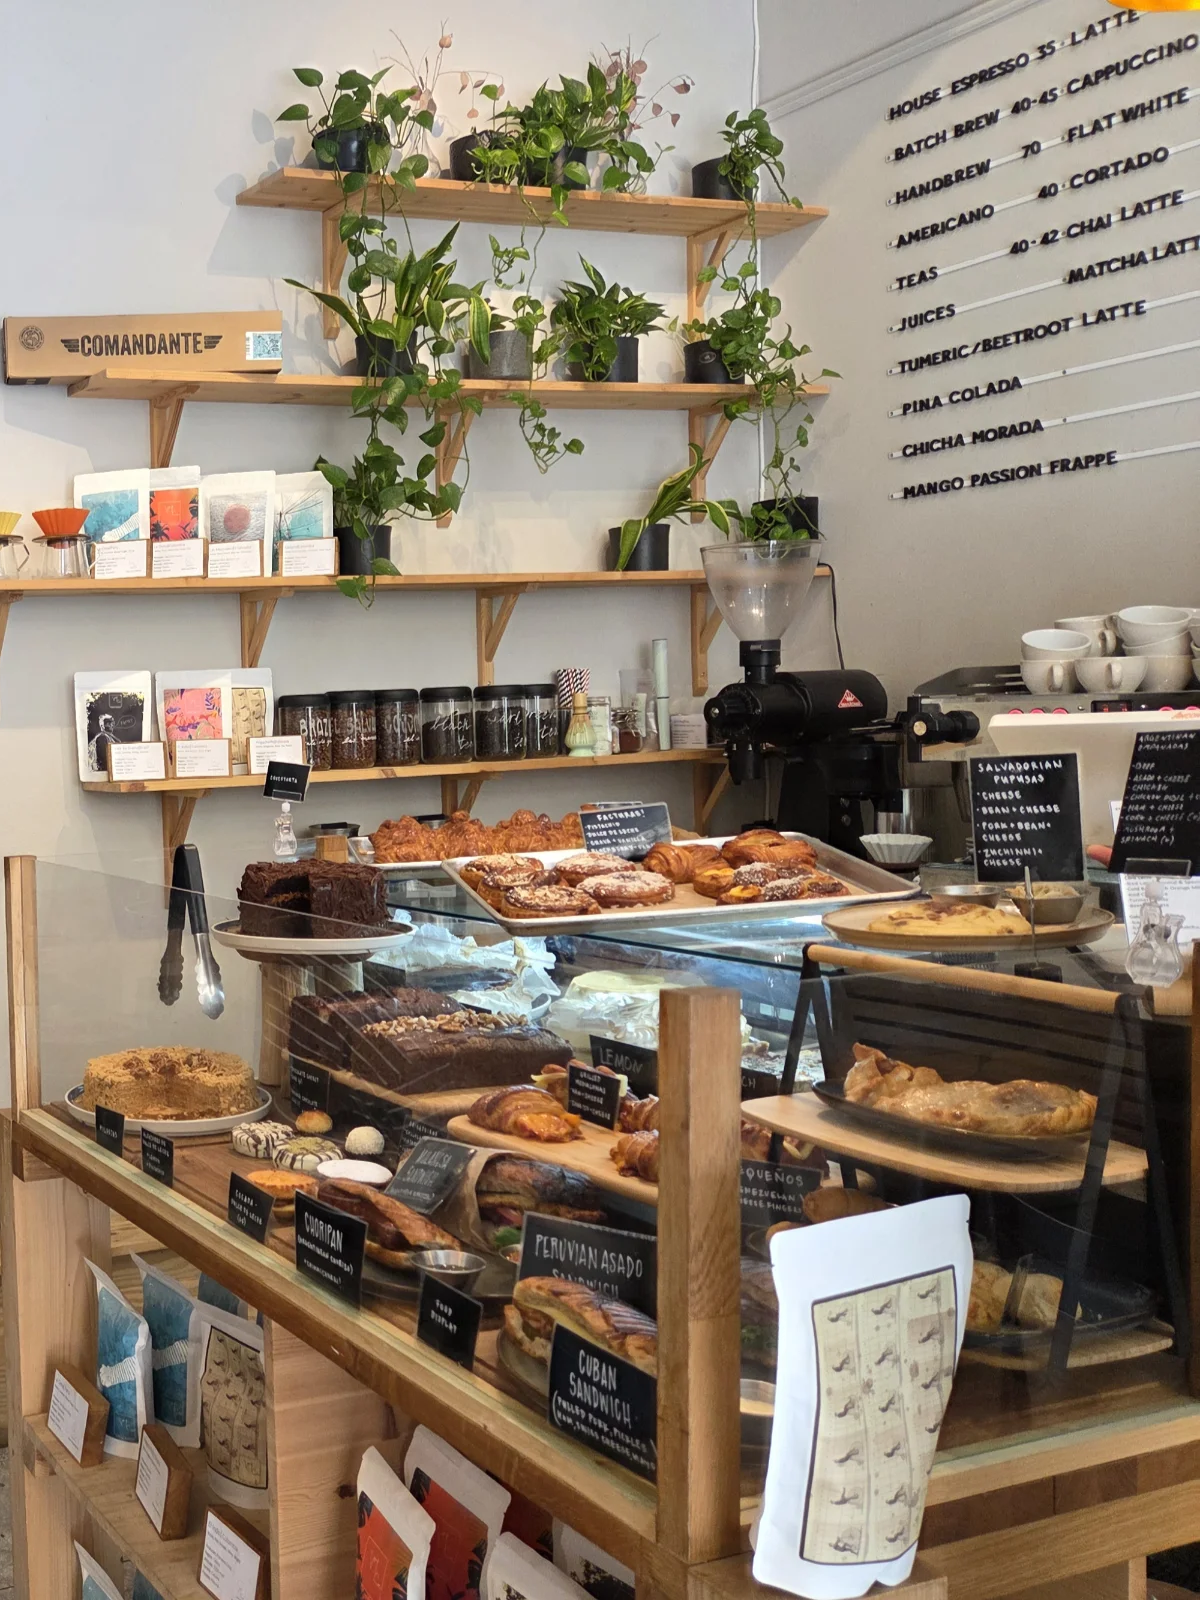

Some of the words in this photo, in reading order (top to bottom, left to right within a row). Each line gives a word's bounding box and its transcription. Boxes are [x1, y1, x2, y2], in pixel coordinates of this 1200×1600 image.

[890, 88, 941, 120] HOUSE
[952, 53, 1029, 95] ESPRESSO
[1037, 41, 1056, 59] 35
[1071, 7, 1139, 46] LATTE
[894, 130, 946, 161] BATCH
[954, 109, 1000, 137] BREW
[1011, 88, 1059, 114] 40-45
[1067, 34, 1198, 94] CAPPUCCINO
[896, 159, 991, 204] HANDBREW
[1022, 141, 1041, 158] 70
[1068, 113, 1116, 142] FLAT
[1122, 87, 1189, 123] WHITE
[897, 204, 994, 248] AMERICANO
[1038, 183, 1058, 199] 40
[1070, 147, 1169, 189] CORTADO
[896, 266, 938, 290] TEAS
[1067, 215, 1112, 238] CHAI
[1121, 190, 1184, 220] LATTE
[898, 304, 955, 331] JUICES
[1068, 251, 1148, 284] MATCHA
[1152, 235, 1200, 260] LATT
[1083, 300, 1147, 326] LATTE
[81, 333, 203, 356] COMANDANTE
[902, 396, 942, 415] PINA
[949, 376, 1022, 404] COLADA
[902, 434, 965, 458] CHICHA
[972, 419, 1044, 444] MORADA
[903, 477, 964, 499] MANGO
[971, 463, 1042, 487] PASSION
[1050, 451, 1118, 474] FRAPPE
[978, 760, 1062, 772] SALVADORIAN
[994, 774, 1044, 784] PUPUSAS
[982, 790, 1021, 800] CHEESE
[982, 806, 1009, 814] BEAN
[1020, 804, 1060, 814] CHEESE
[982, 822, 1008, 830] PORK
[1017, 821, 1046, 830] BEAN
[982, 833, 1021, 842] CHEESE
[984, 858, 1022, 866] CHEESE
[600, 1048, 643, 1074] LEMON
[304, 1211, 343, 1253] CHORIPAN
[535, 1234, 598, 1270] PERUVIAN
[601, 1250, 643, 1278] ASADO
[431, 1310, 457, 1334] DISPLAY
[579, 1349, 616, 1391] CUBAN
[570, 1372, 631, 1429] SANDWICH
